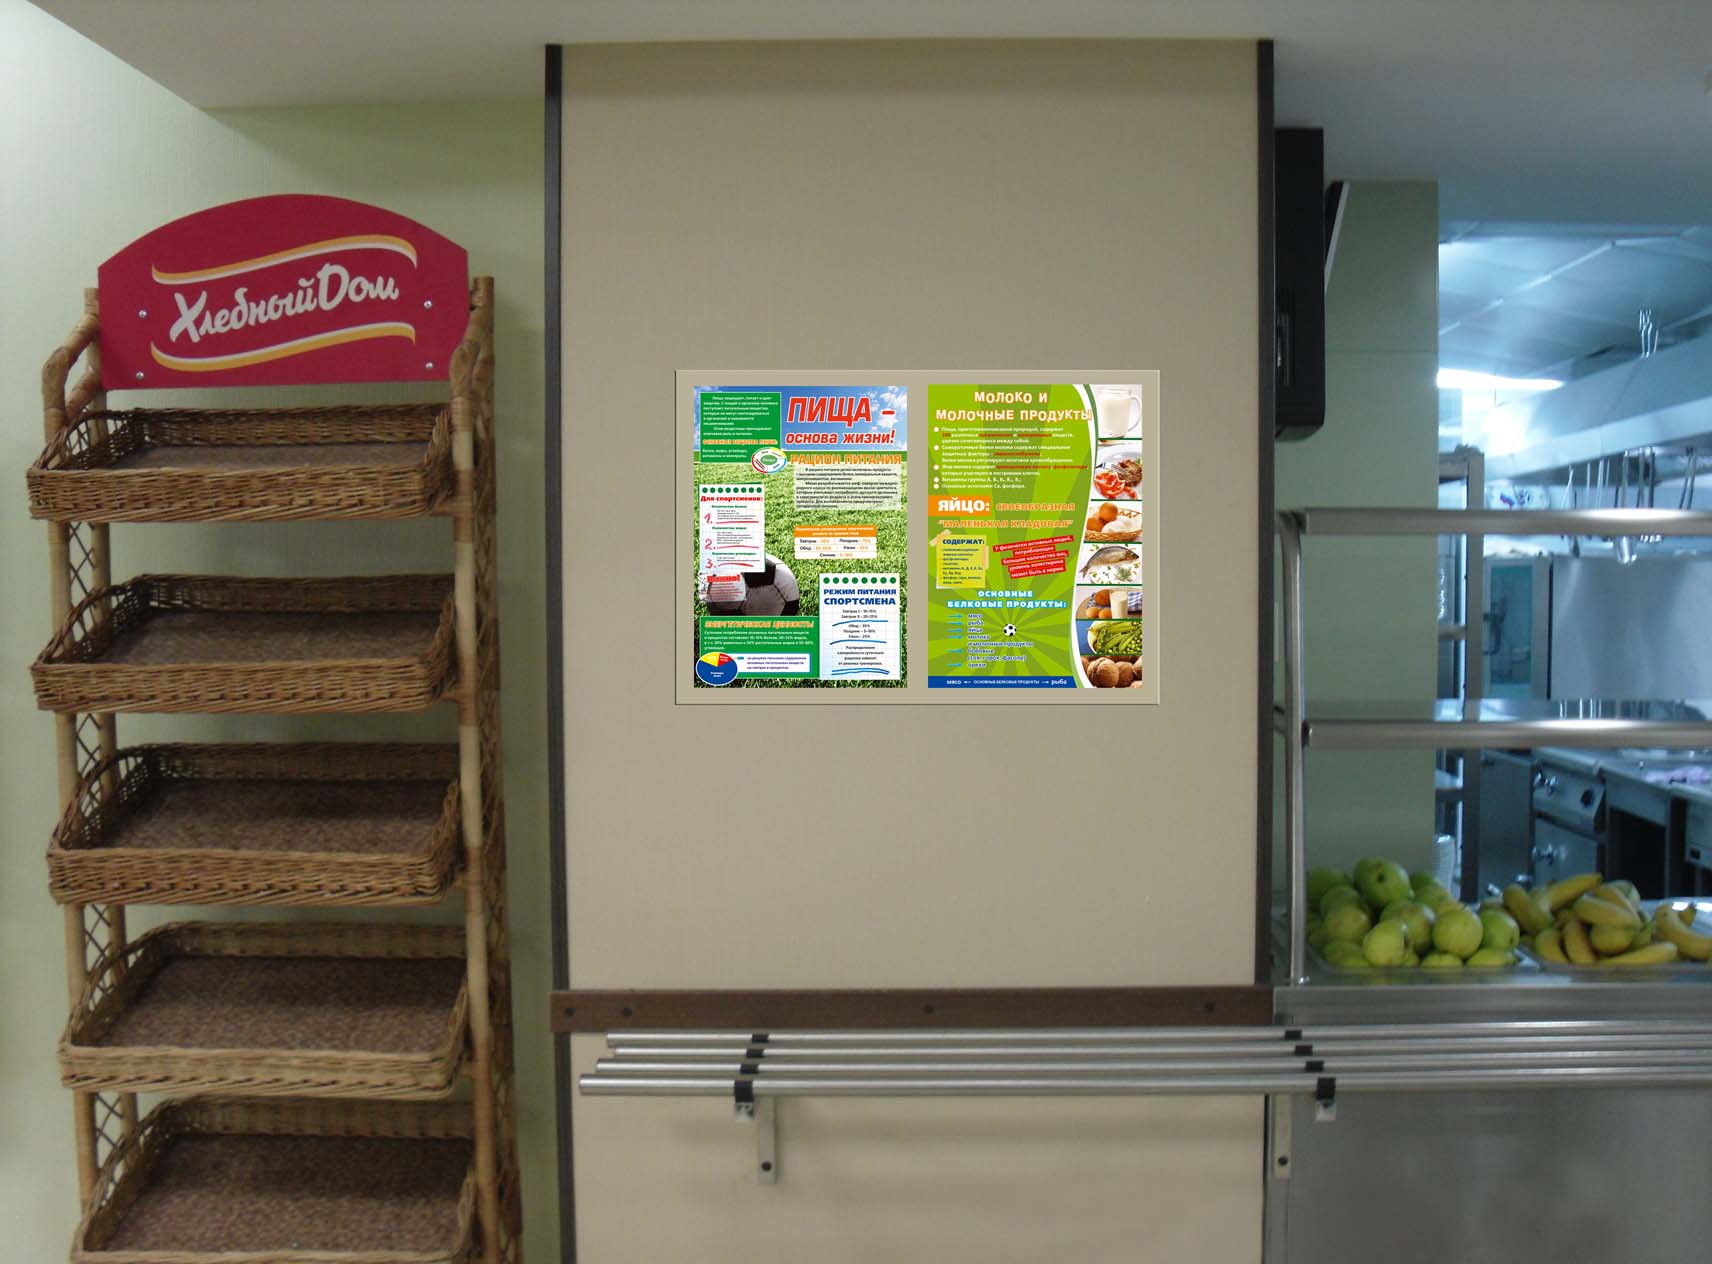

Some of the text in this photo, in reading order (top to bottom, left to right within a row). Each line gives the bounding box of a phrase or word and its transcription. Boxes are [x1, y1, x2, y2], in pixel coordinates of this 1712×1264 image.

[974, 391, 1048, 404] МОЛОКО И
[787, 397, 873, 428] ПИЩА
[935, 409, 1093, 422] МОЛОЧНЫЕ ПРОДУКТЫ
[786, 433, 838, 444] основа
[842, 429, 896, 445] жизни!
[790, 454, 841, 466] РАЦИОН
[844, 454, 902, 464] ПИТАНИЯ
[977, 590, 1033, 598] ОСНОВНЫЕ
[824, 597, 897, 605] СПОРТСМЕНА
[947, 600, 1067, 609] БЕЛКОВЫЕ ПРОДУКТЫ:
